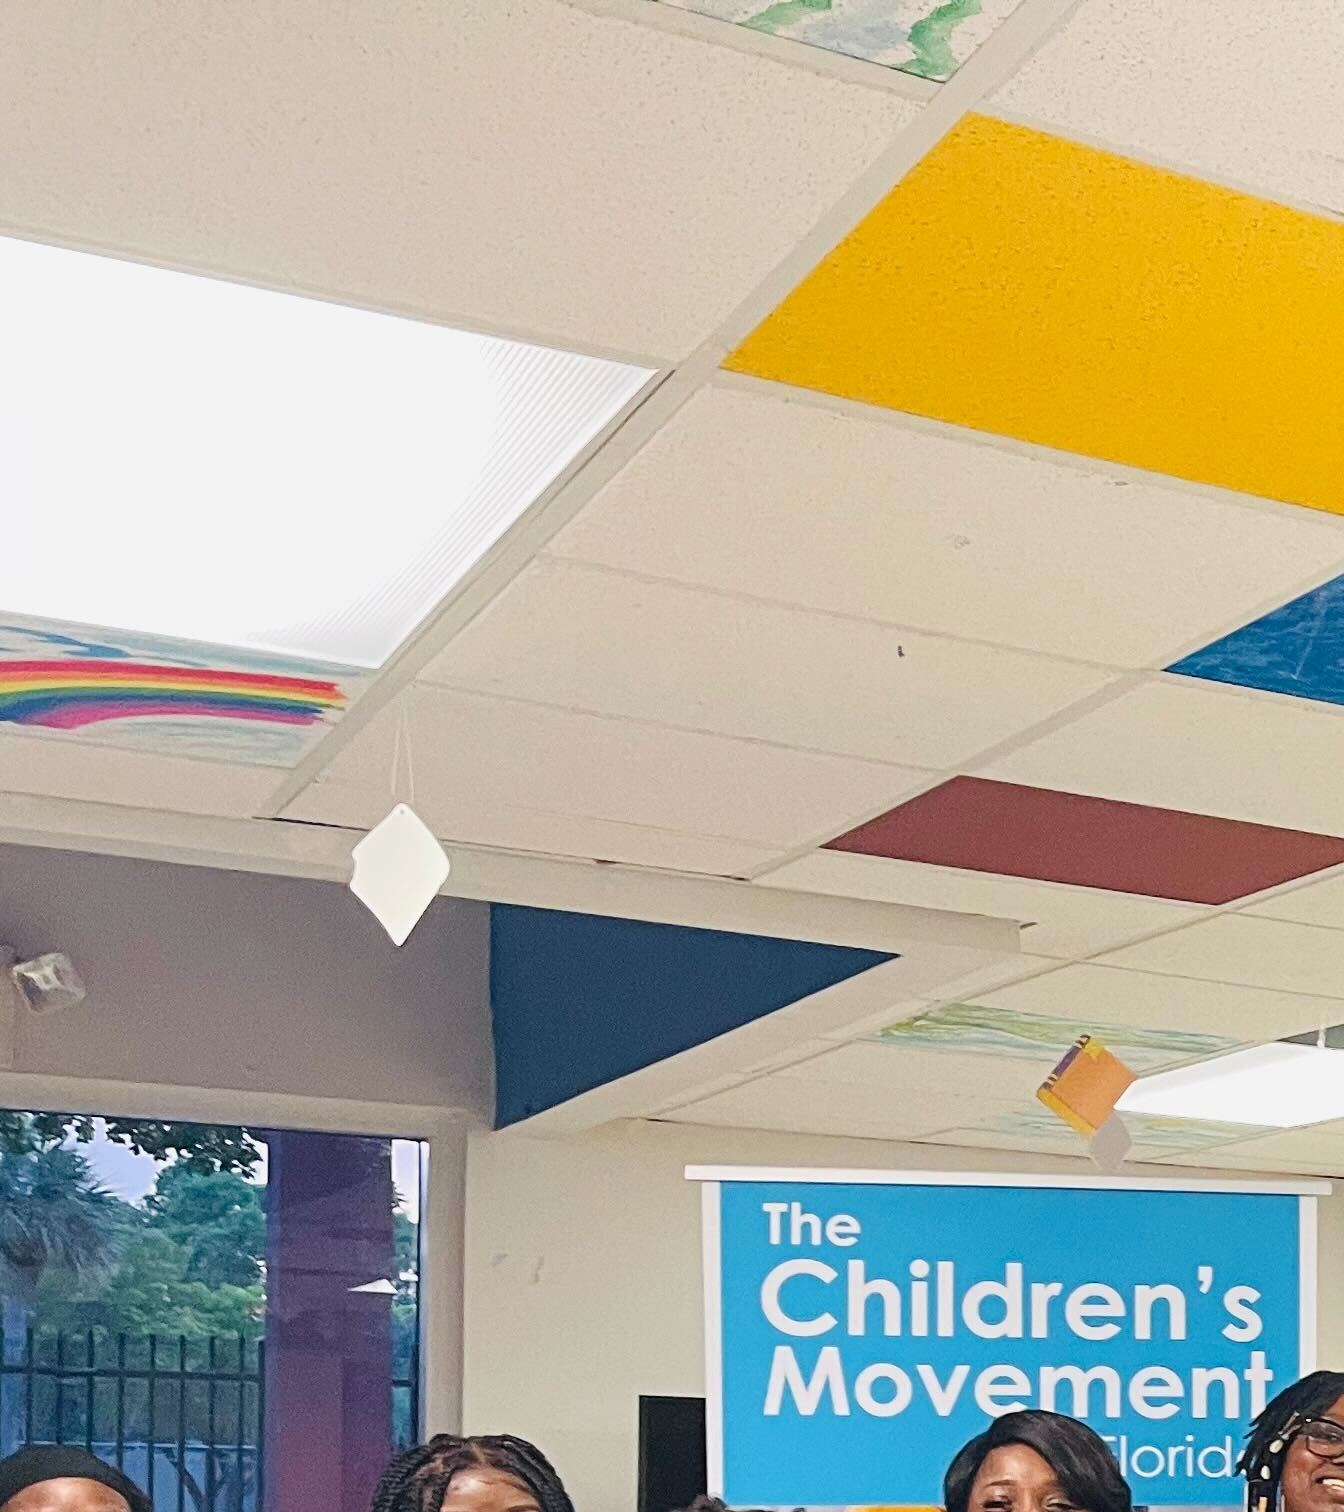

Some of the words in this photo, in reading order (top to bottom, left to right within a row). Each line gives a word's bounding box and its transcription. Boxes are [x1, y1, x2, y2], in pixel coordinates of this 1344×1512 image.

[762, 1202, 862, 1247] The
[760, 1258, 1264, 1343] Children's
[763, 1345, 1273, 1419] Movement
[1101, 1434, 1248, 1478] lorid
